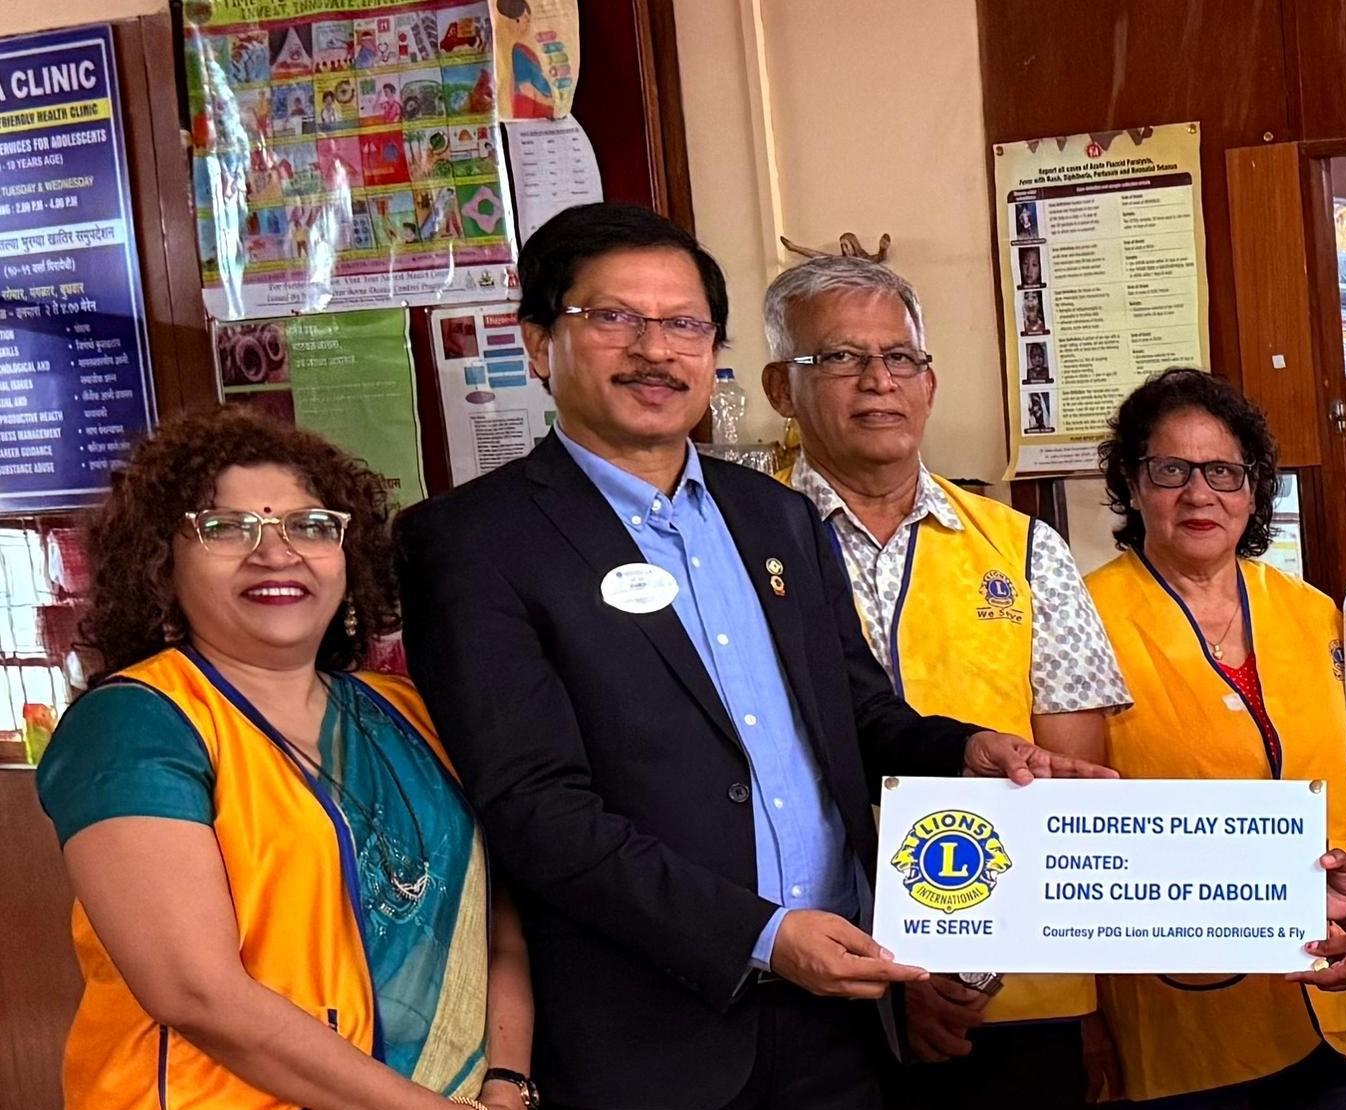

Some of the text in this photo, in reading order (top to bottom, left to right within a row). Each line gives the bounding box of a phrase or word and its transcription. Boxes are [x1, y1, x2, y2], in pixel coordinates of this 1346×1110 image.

[11, 60, 96, 99] CLINIC
[38, 103, 98, 122] HEALTH CLINIC
[34, 129, 106, 151] FOR ADOLESCENTS
[16, 157, 42, 170] YEARS
[2, 184, 36, 197] TUESDAY
[45, 176, 93, 191] WEDNESDAY
[920, 813, 987, 838] LIONS
[1046, 816, 1304, 834] CHILDREN'S PLAY STATION
[939, 842, 969, 878] L
[1046, 855, 1128, 870] DONATED:
[916, 884, 984, 906] INTERNATIONAL
[1045, 883, 1287, 901] LIONS CLUB OF DABOLIM
[904, 920, 993, 935] WE SERVE
[1043, 926, 1305, 941] Courtesy PDG Lion ULARICO RODRIGUES & Fly
